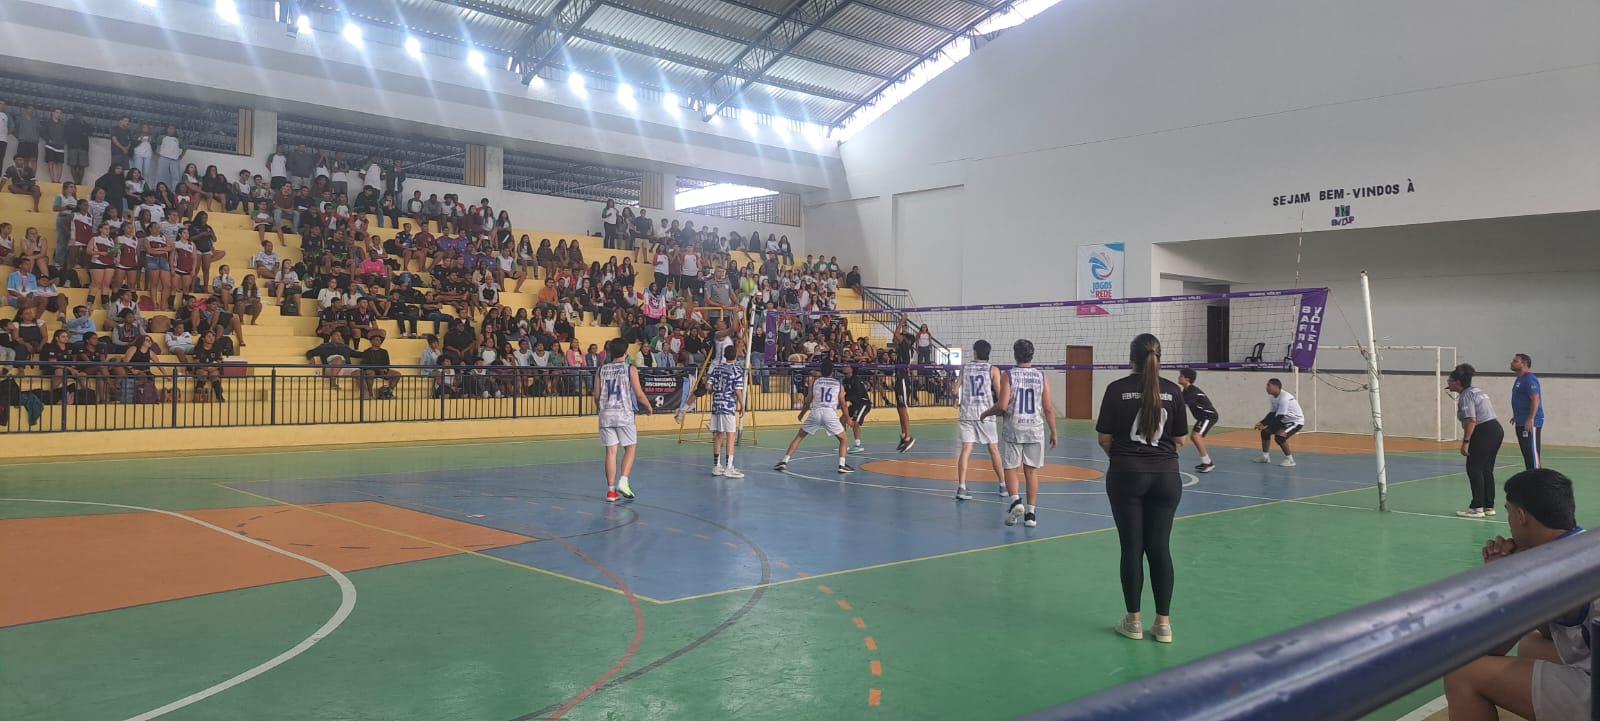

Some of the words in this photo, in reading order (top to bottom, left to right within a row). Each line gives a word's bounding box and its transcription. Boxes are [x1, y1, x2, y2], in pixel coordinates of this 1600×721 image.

[1272, 192, 1311, 206] SEJAM
[1319, 184, 1400, 201] BEM-VINDOS
[1407, 178, 1415, 193] À
[1090, 282, 1112, 293] JOGOS
[1096, 290, 1112, 298] REDE
[1296, 306, 1311, 350] BARRA
[1307, 306, 1322, 351] VÔLEI
[605, 379, 621, 401] 14
[820, 387, 832, 403] 16
[969, 375, 985, 396] 12
[1018, 388, 1035, 414] 10
